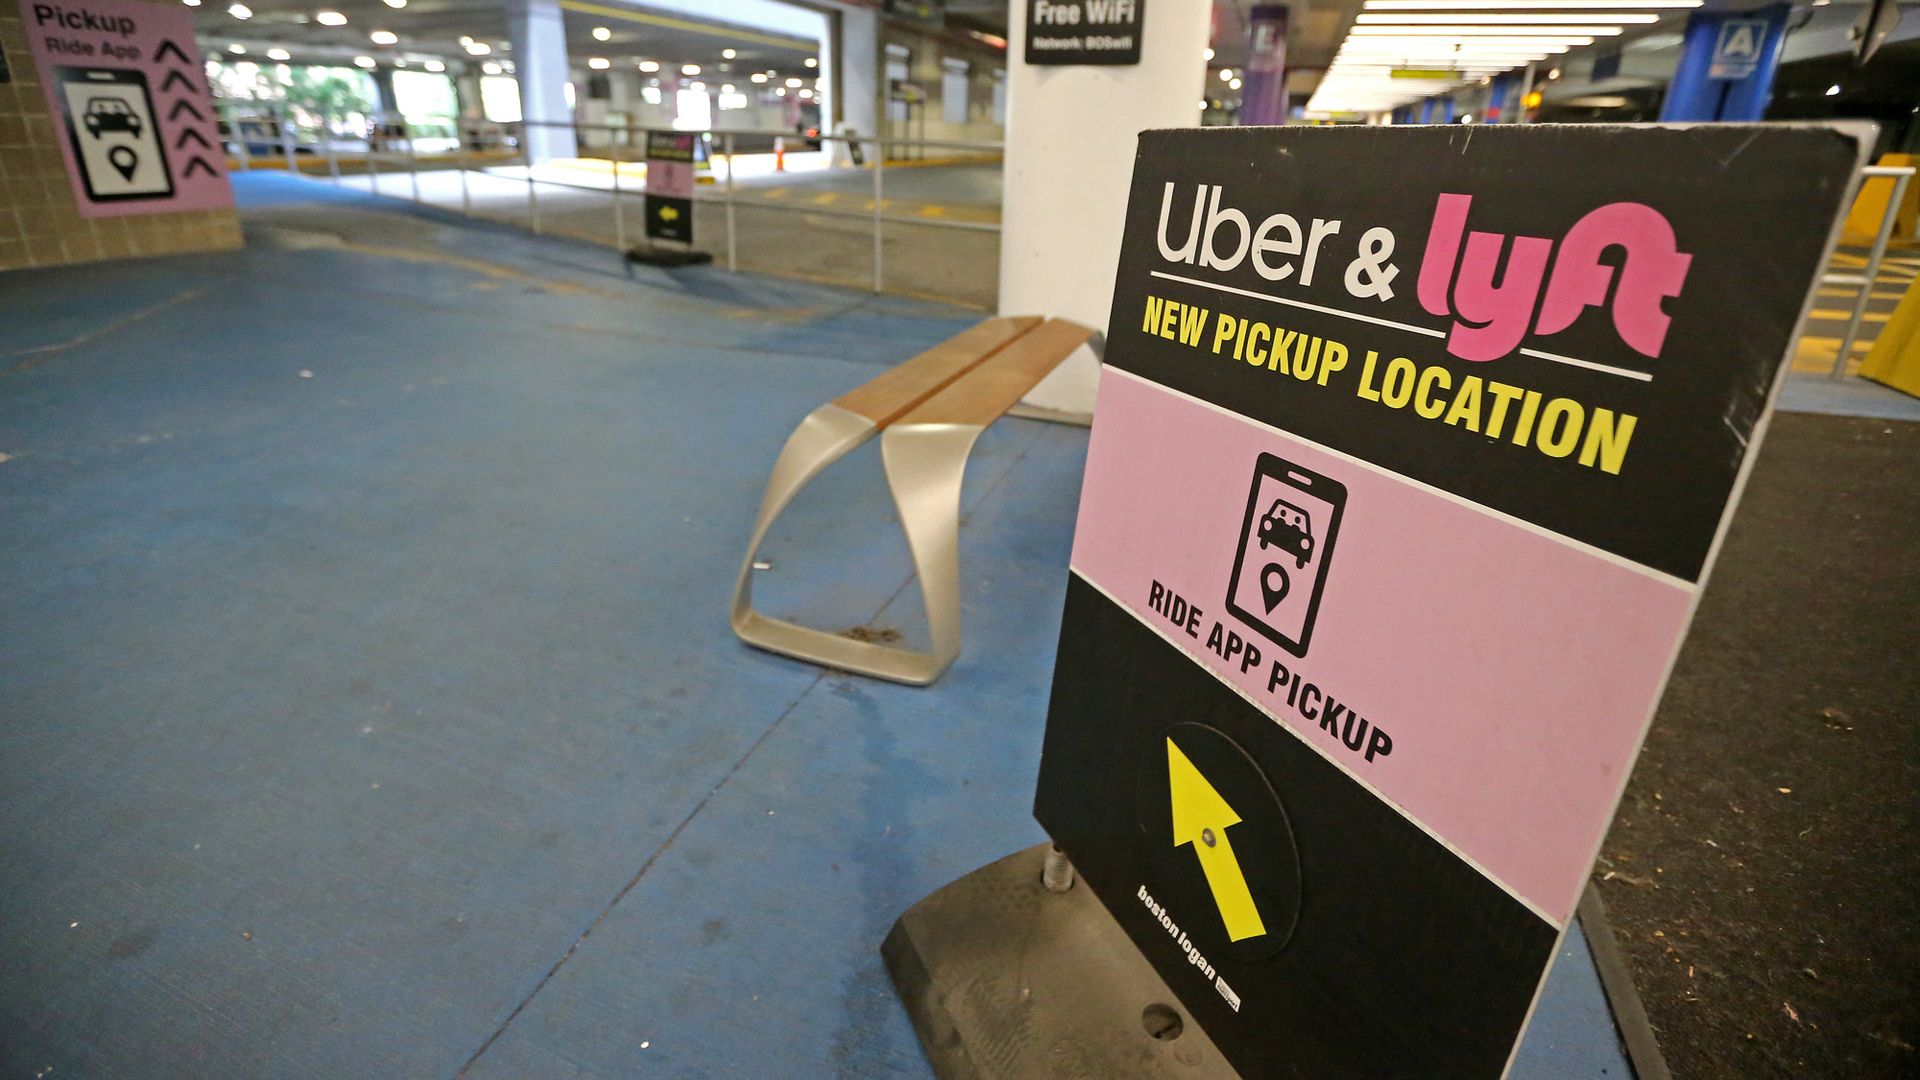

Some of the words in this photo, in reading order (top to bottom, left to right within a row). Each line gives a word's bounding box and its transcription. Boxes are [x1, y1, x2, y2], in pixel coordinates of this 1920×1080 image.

[33, 4, 136, 40] Pickup
[1034, 0, 1081, 25] Free
[1085, 0, 1135, 25] WiFi
[1722, 26, 1755, 57] A
[45, 36, 94, 57] Ride
[100, 41, 141, 60] App
[1156, 181, 1341, 286] Uber
[1344, 227, 1400, 302] &
[1417, 193, 1693, 362] lyft
[1142, 296, 1208, 347] NEW
[1212, 318, 1349, 387] PICKUP
[1357, 351, 1638, 475] LOCATION
[1148, 579, 1203, 640] RIDE
[1206, 621, 1262, 675] APP
[1267, 660, 1393, 764] PICKUP
[1137, 884, 1180, 939] boston
[1177, 931, 1217, 981] logan
